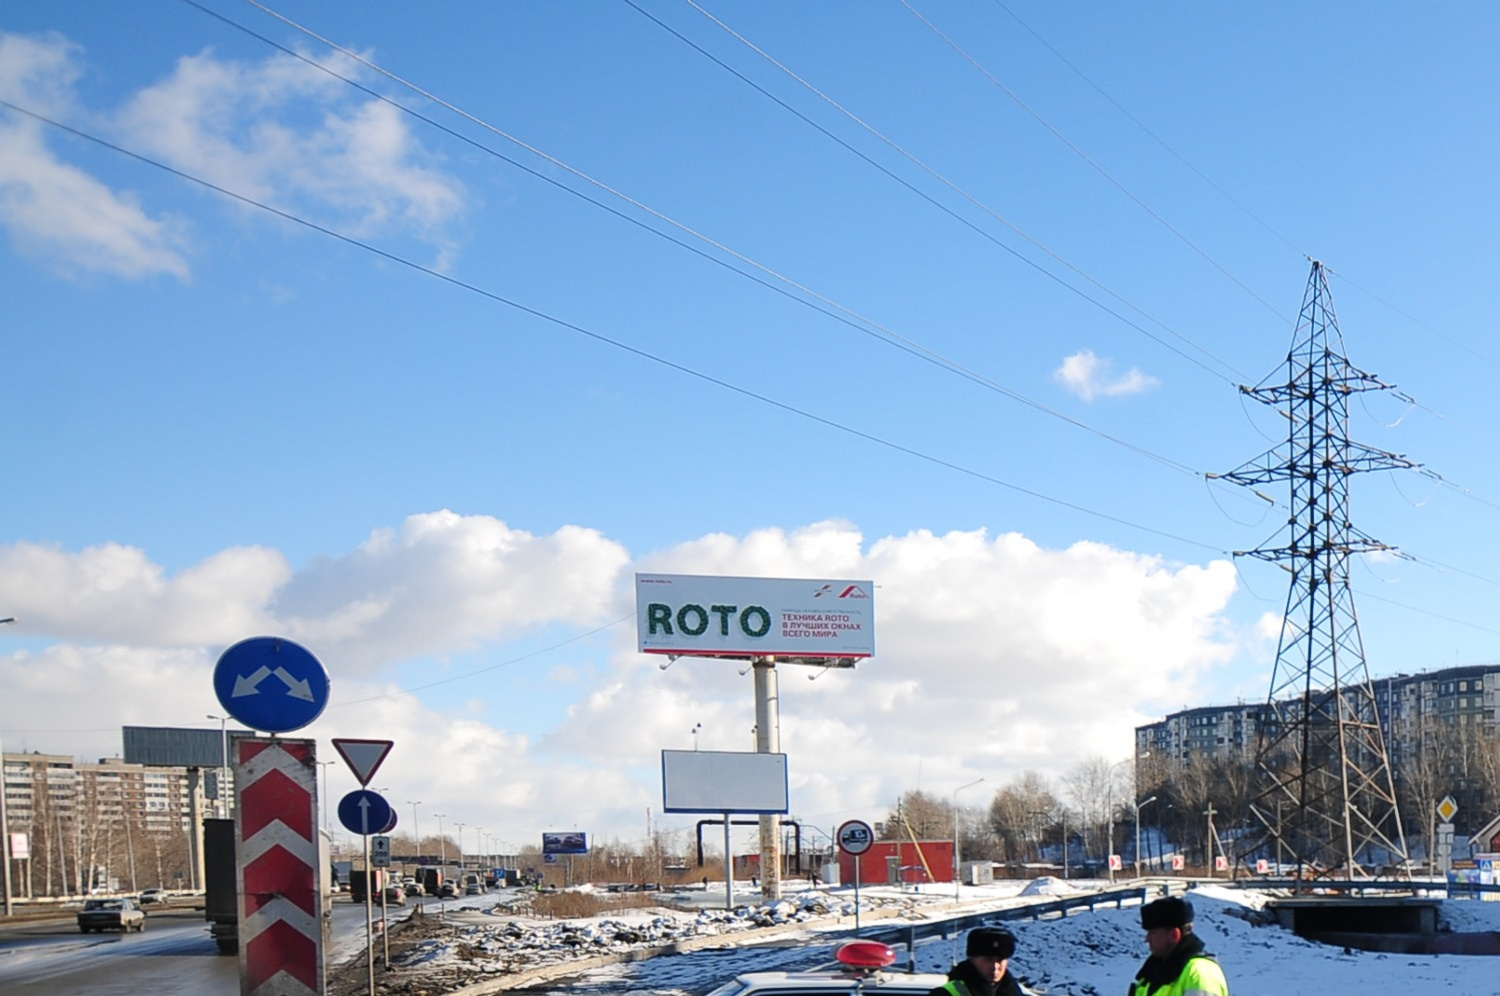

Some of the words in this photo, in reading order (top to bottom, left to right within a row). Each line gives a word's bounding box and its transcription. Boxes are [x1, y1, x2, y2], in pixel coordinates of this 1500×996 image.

[648, 603, 771, 637] ROTO
[782, 613, 823, 622] ТЕХНИКА
[825, 614, 849, 622] ROTO
[790, 622, 829, 630] ЛУЧШИХ
[831, 623, 862, 631] ОКНАХ
[783, 630, 811, 638] ВСЕГО
[812, 630, 838, 638] МИРА
